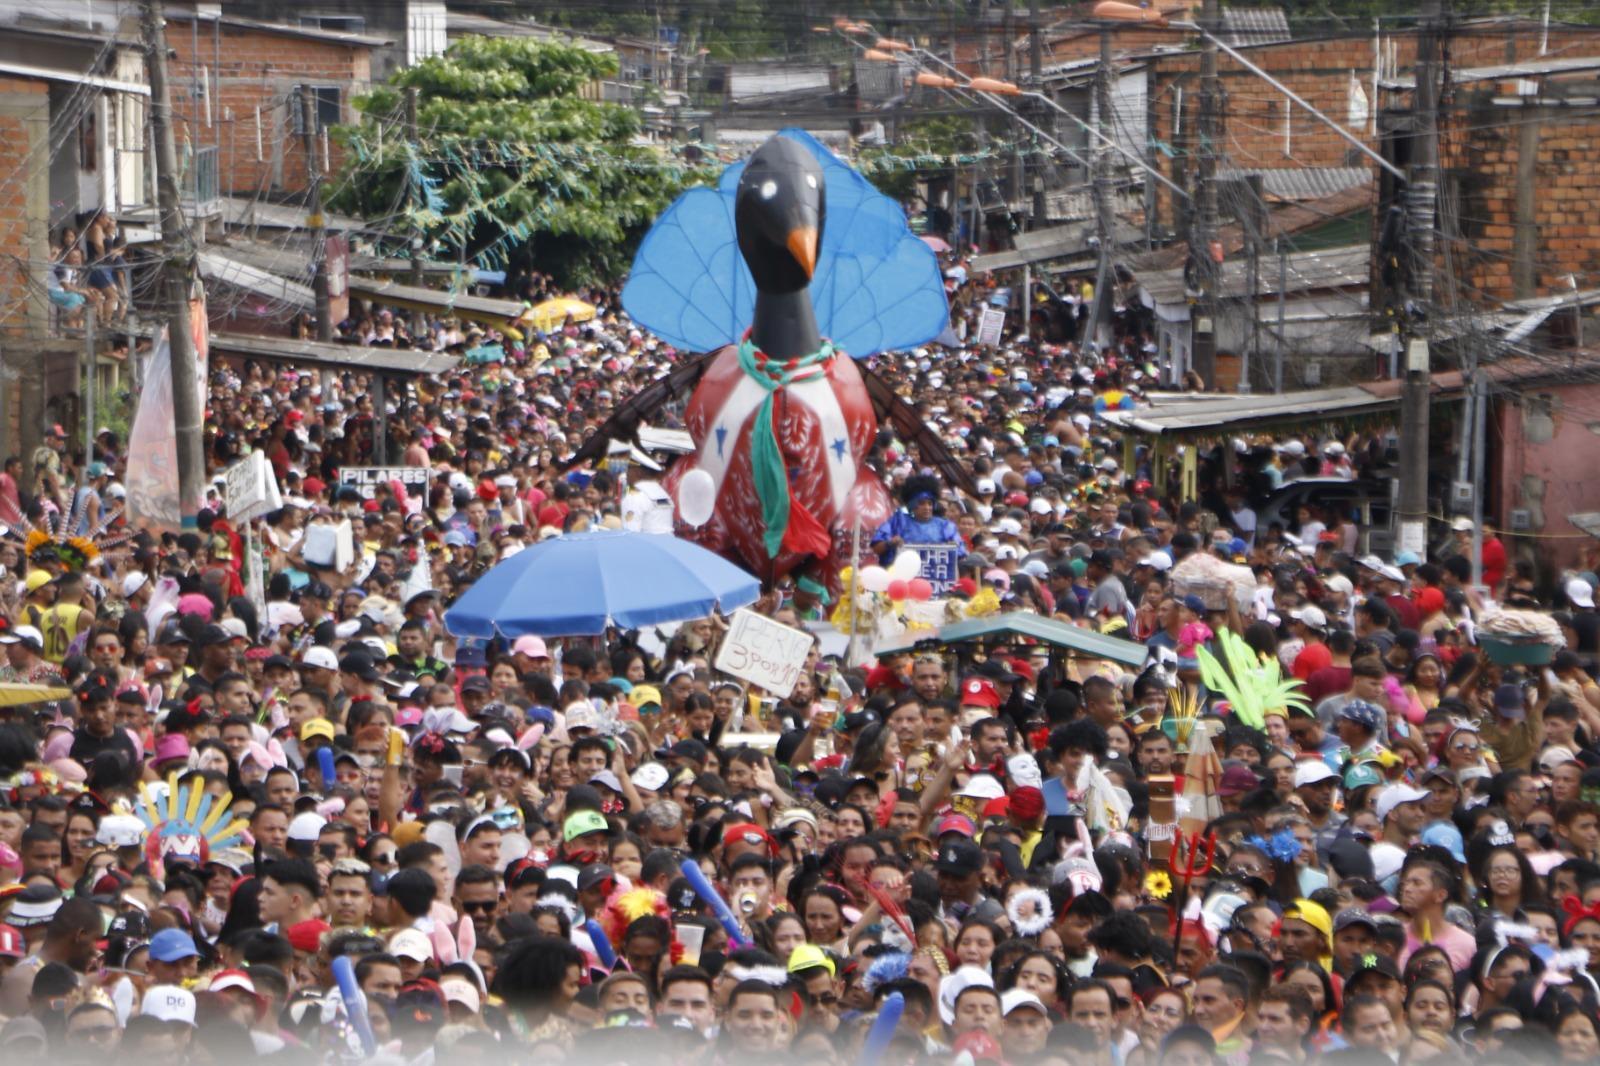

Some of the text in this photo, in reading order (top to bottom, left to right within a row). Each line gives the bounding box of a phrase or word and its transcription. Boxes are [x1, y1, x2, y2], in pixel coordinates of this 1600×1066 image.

[342, 469, 426, 485] PILARES
[47, 625, 71, 656] 10
[727, 641, 749, 670] 3
[1489, 832, 1516, 846] UBER
